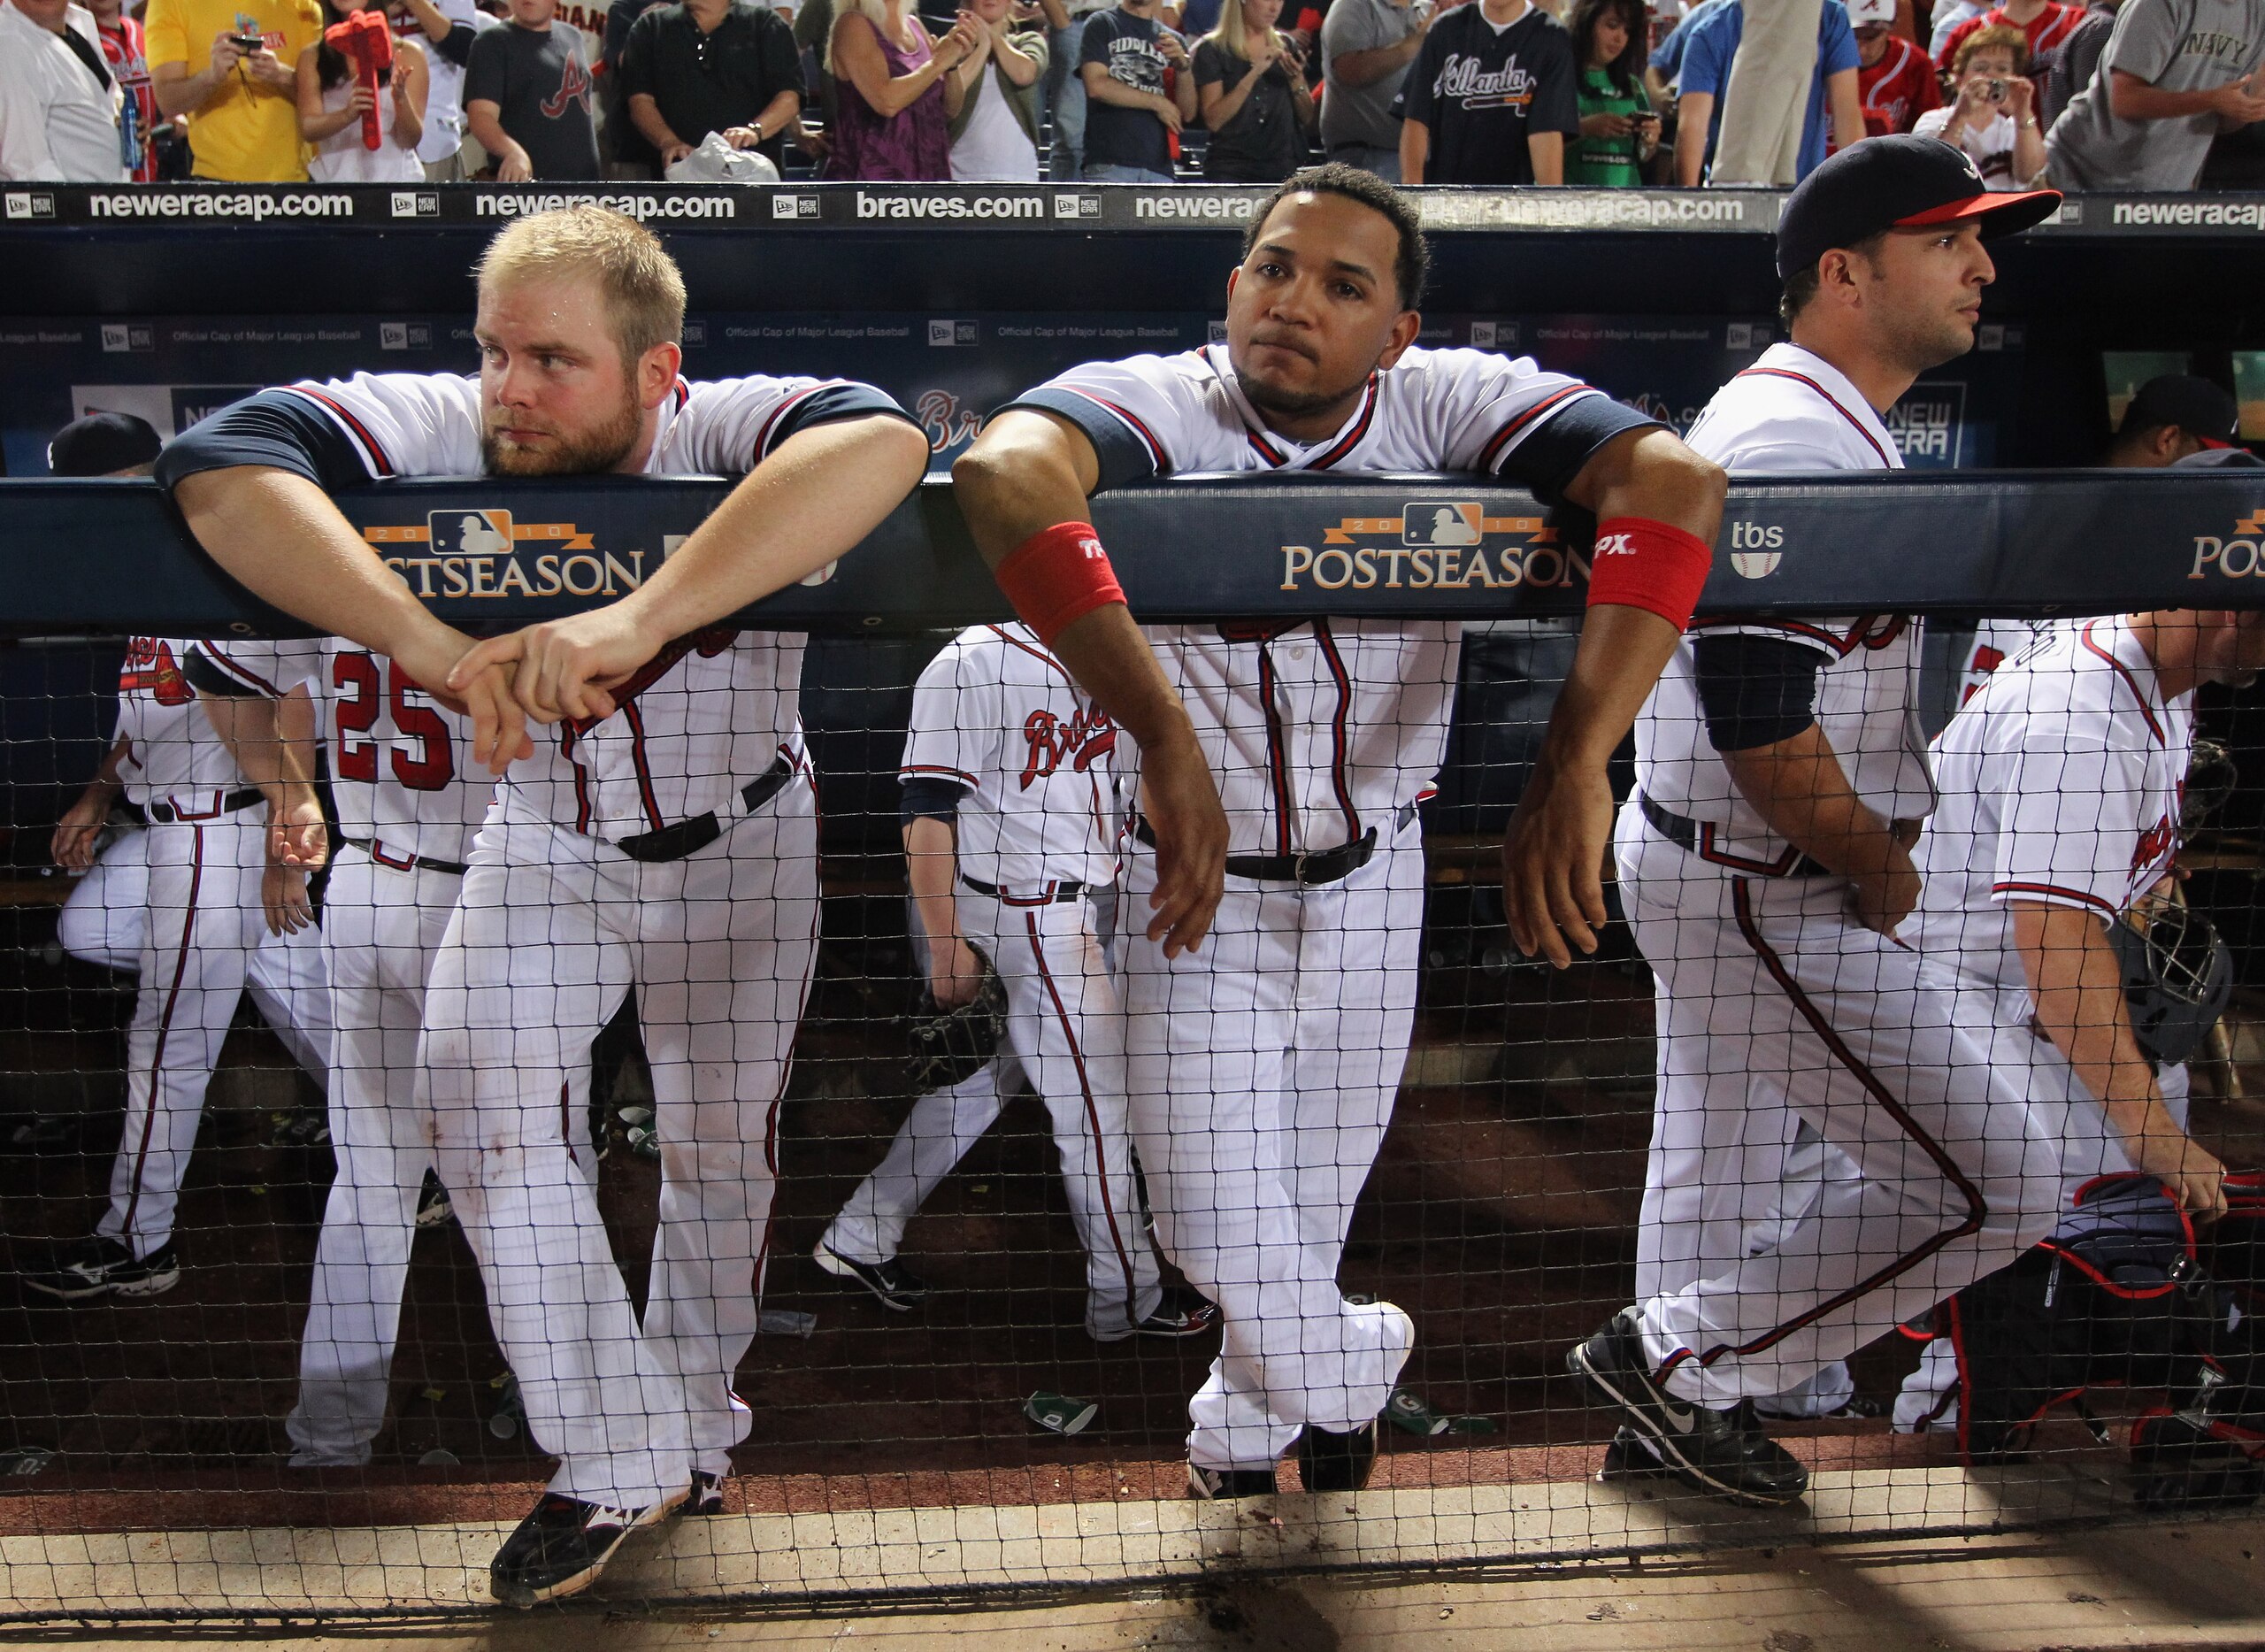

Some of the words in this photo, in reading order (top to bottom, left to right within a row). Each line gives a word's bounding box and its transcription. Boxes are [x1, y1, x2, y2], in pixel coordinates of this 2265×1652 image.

[2184, 33, 2248, 65] NAVY
[1433, 53, 1538, 98] Atlanta
[90, 194, 353, 221] neweracap.com
[856, 191, 1043, 219] braves.com
[1501, 197, 1743, 225] neweracap.com
[173, 330, 208, 342] Official
[211, 330, 231, 342] Cap
[234, 329, 245, 342] of
[247, 330, 274, 342] Major
[277, 330, 316, 342] League
[319, 330, 361, 342] Baseball
[726, 327, 760, 339] Official
[762, 327, 783, 339] Cap
[785, 327, 796, 339] of
[798, 327, 825, 339] Major
[828, 327, 864, 339] League
[867, 327, 909, 339] Baseball
[998, 327, 1033, 338] Official
[1034, 327, 1054, 338] Cap
[1056, 326, 1067, 338] of
[1069, 327, 1096, 338] Major
[1099, 327, 1135, 338] League
[1138, 327, 1179, 338] Baseball
[1888, 402, 1952, 428] NEW
[1891, 429, 1949, 455] ERA
[1353, 520, 1390, 531] 20
[1731, 520, 1783, 549] tbs
[384, 549, 644, 598] STSEASON
[1280, 546, 1591, 589] POSTSEASON
[333, 650, 455, 792] 25
